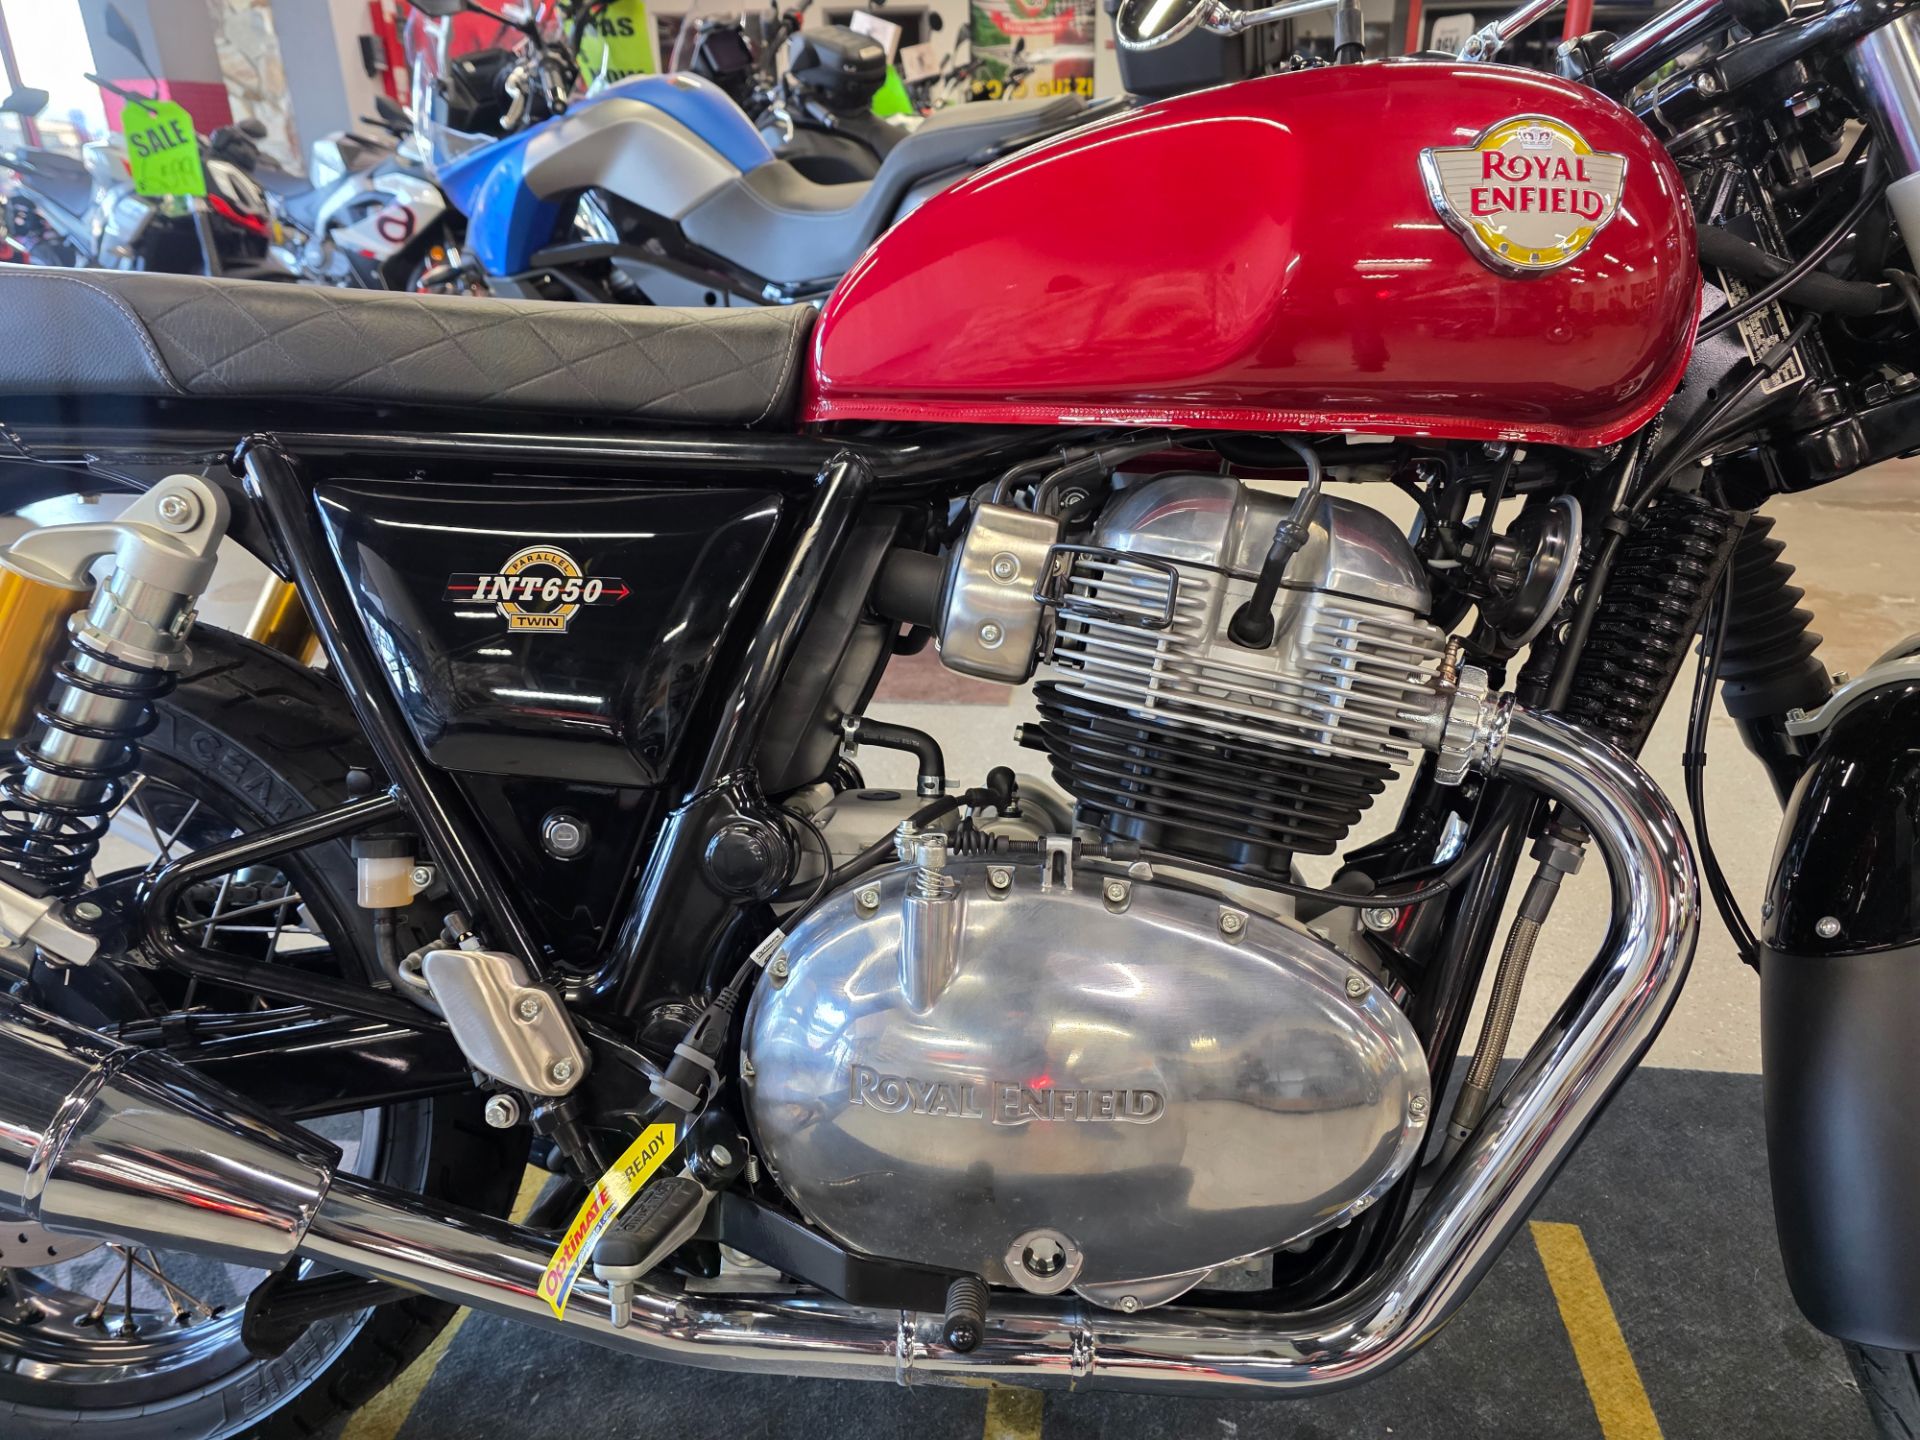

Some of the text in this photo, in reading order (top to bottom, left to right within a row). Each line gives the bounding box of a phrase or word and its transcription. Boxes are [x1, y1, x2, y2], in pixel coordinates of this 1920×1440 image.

[130, 119, 188, 158] SALE
[1482, 150, 1591, 182] ROYAL
[1470, 187, 1604, 221] ENFIELD
[512, 553, 570, 572] PARALLEL
[472, 576, 603, 603] INT650
[516, 616, 559, 627] TWIN
[850, 1064, 1167, 1126] ROYAL ENFIELD
[624, 1131, 666, 1183] READY
